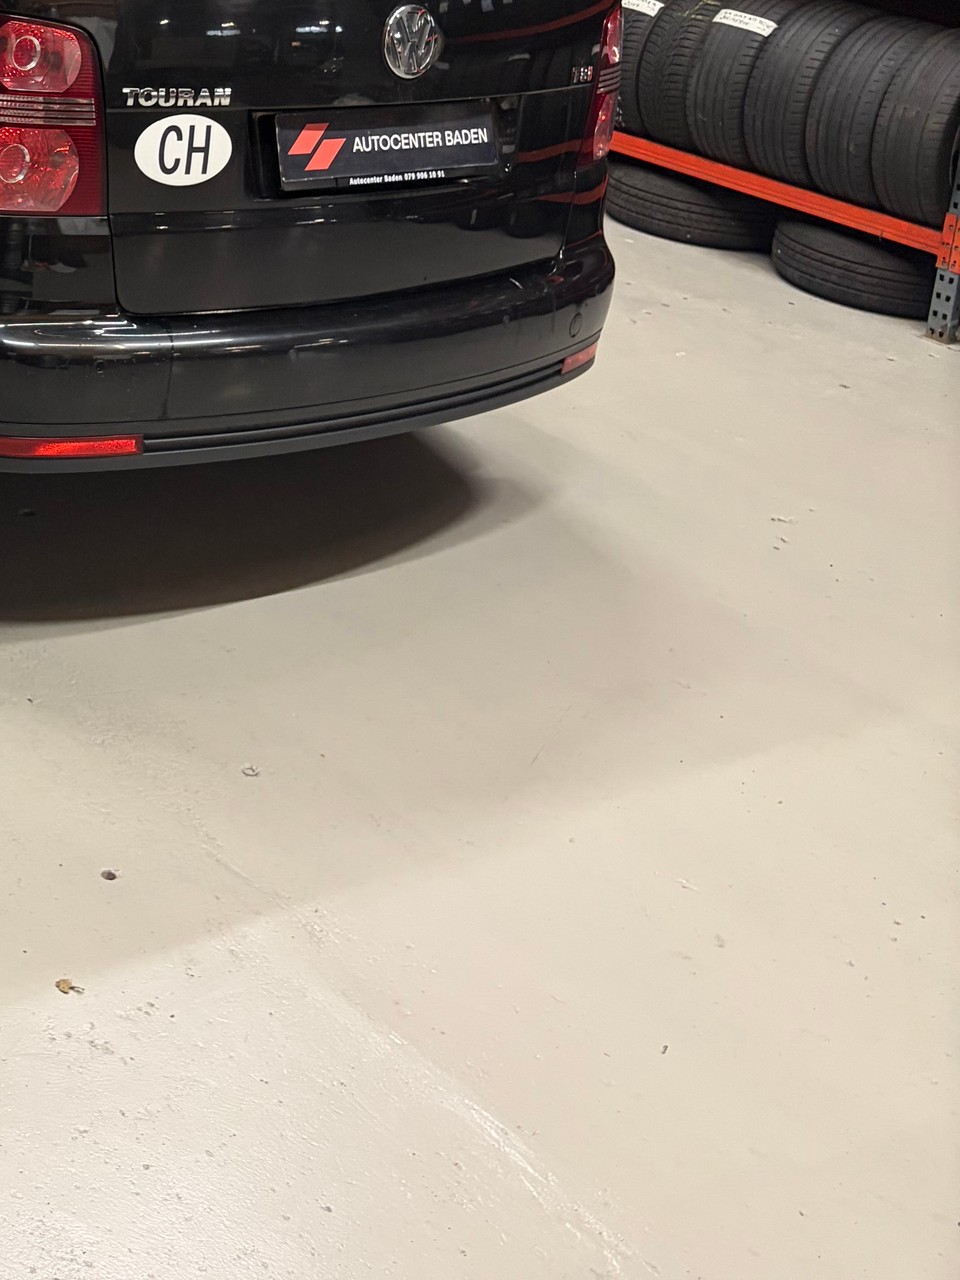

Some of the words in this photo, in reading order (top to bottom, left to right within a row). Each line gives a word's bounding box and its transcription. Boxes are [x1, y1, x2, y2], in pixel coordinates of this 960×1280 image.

[122, 87, 232, 107] TOURAN
[158, 125, 212, 175] CH
[352, 131, 443, 153] AUTOCENTER
[445, 127, 489, 147] BADEN
[349, 176, 383, 186] Autocenter
[383, 173, 403, 183] Baden
[403, 172, 416, 181] 079
[428, 170, 437, 179] 10
